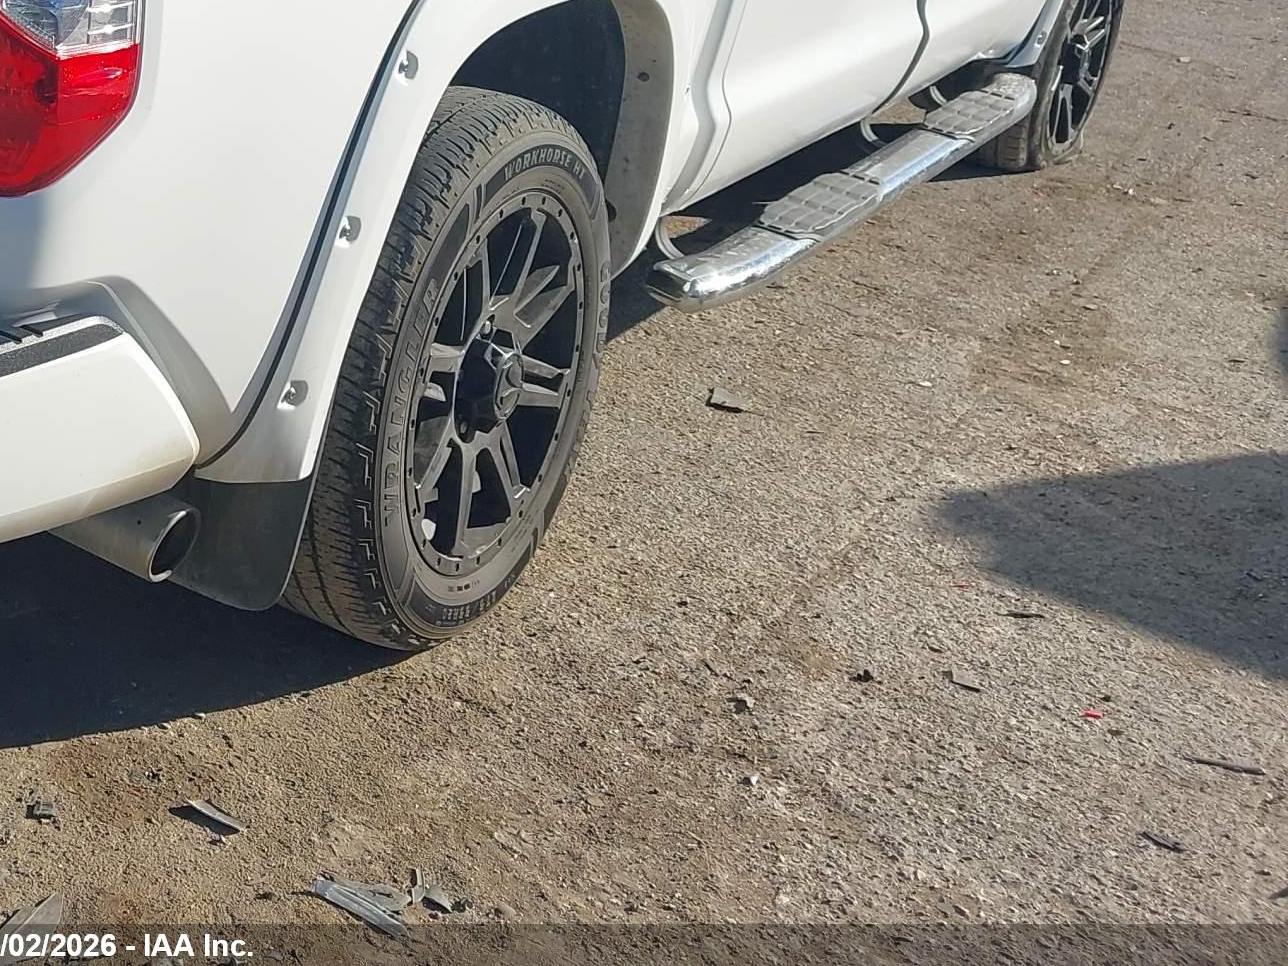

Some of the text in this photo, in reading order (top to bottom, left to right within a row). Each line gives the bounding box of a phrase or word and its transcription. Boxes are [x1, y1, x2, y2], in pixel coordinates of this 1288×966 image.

[504, 147, 589, 181] WORKHORSE HT
[383, 278, 441, 528] WRANGLER
